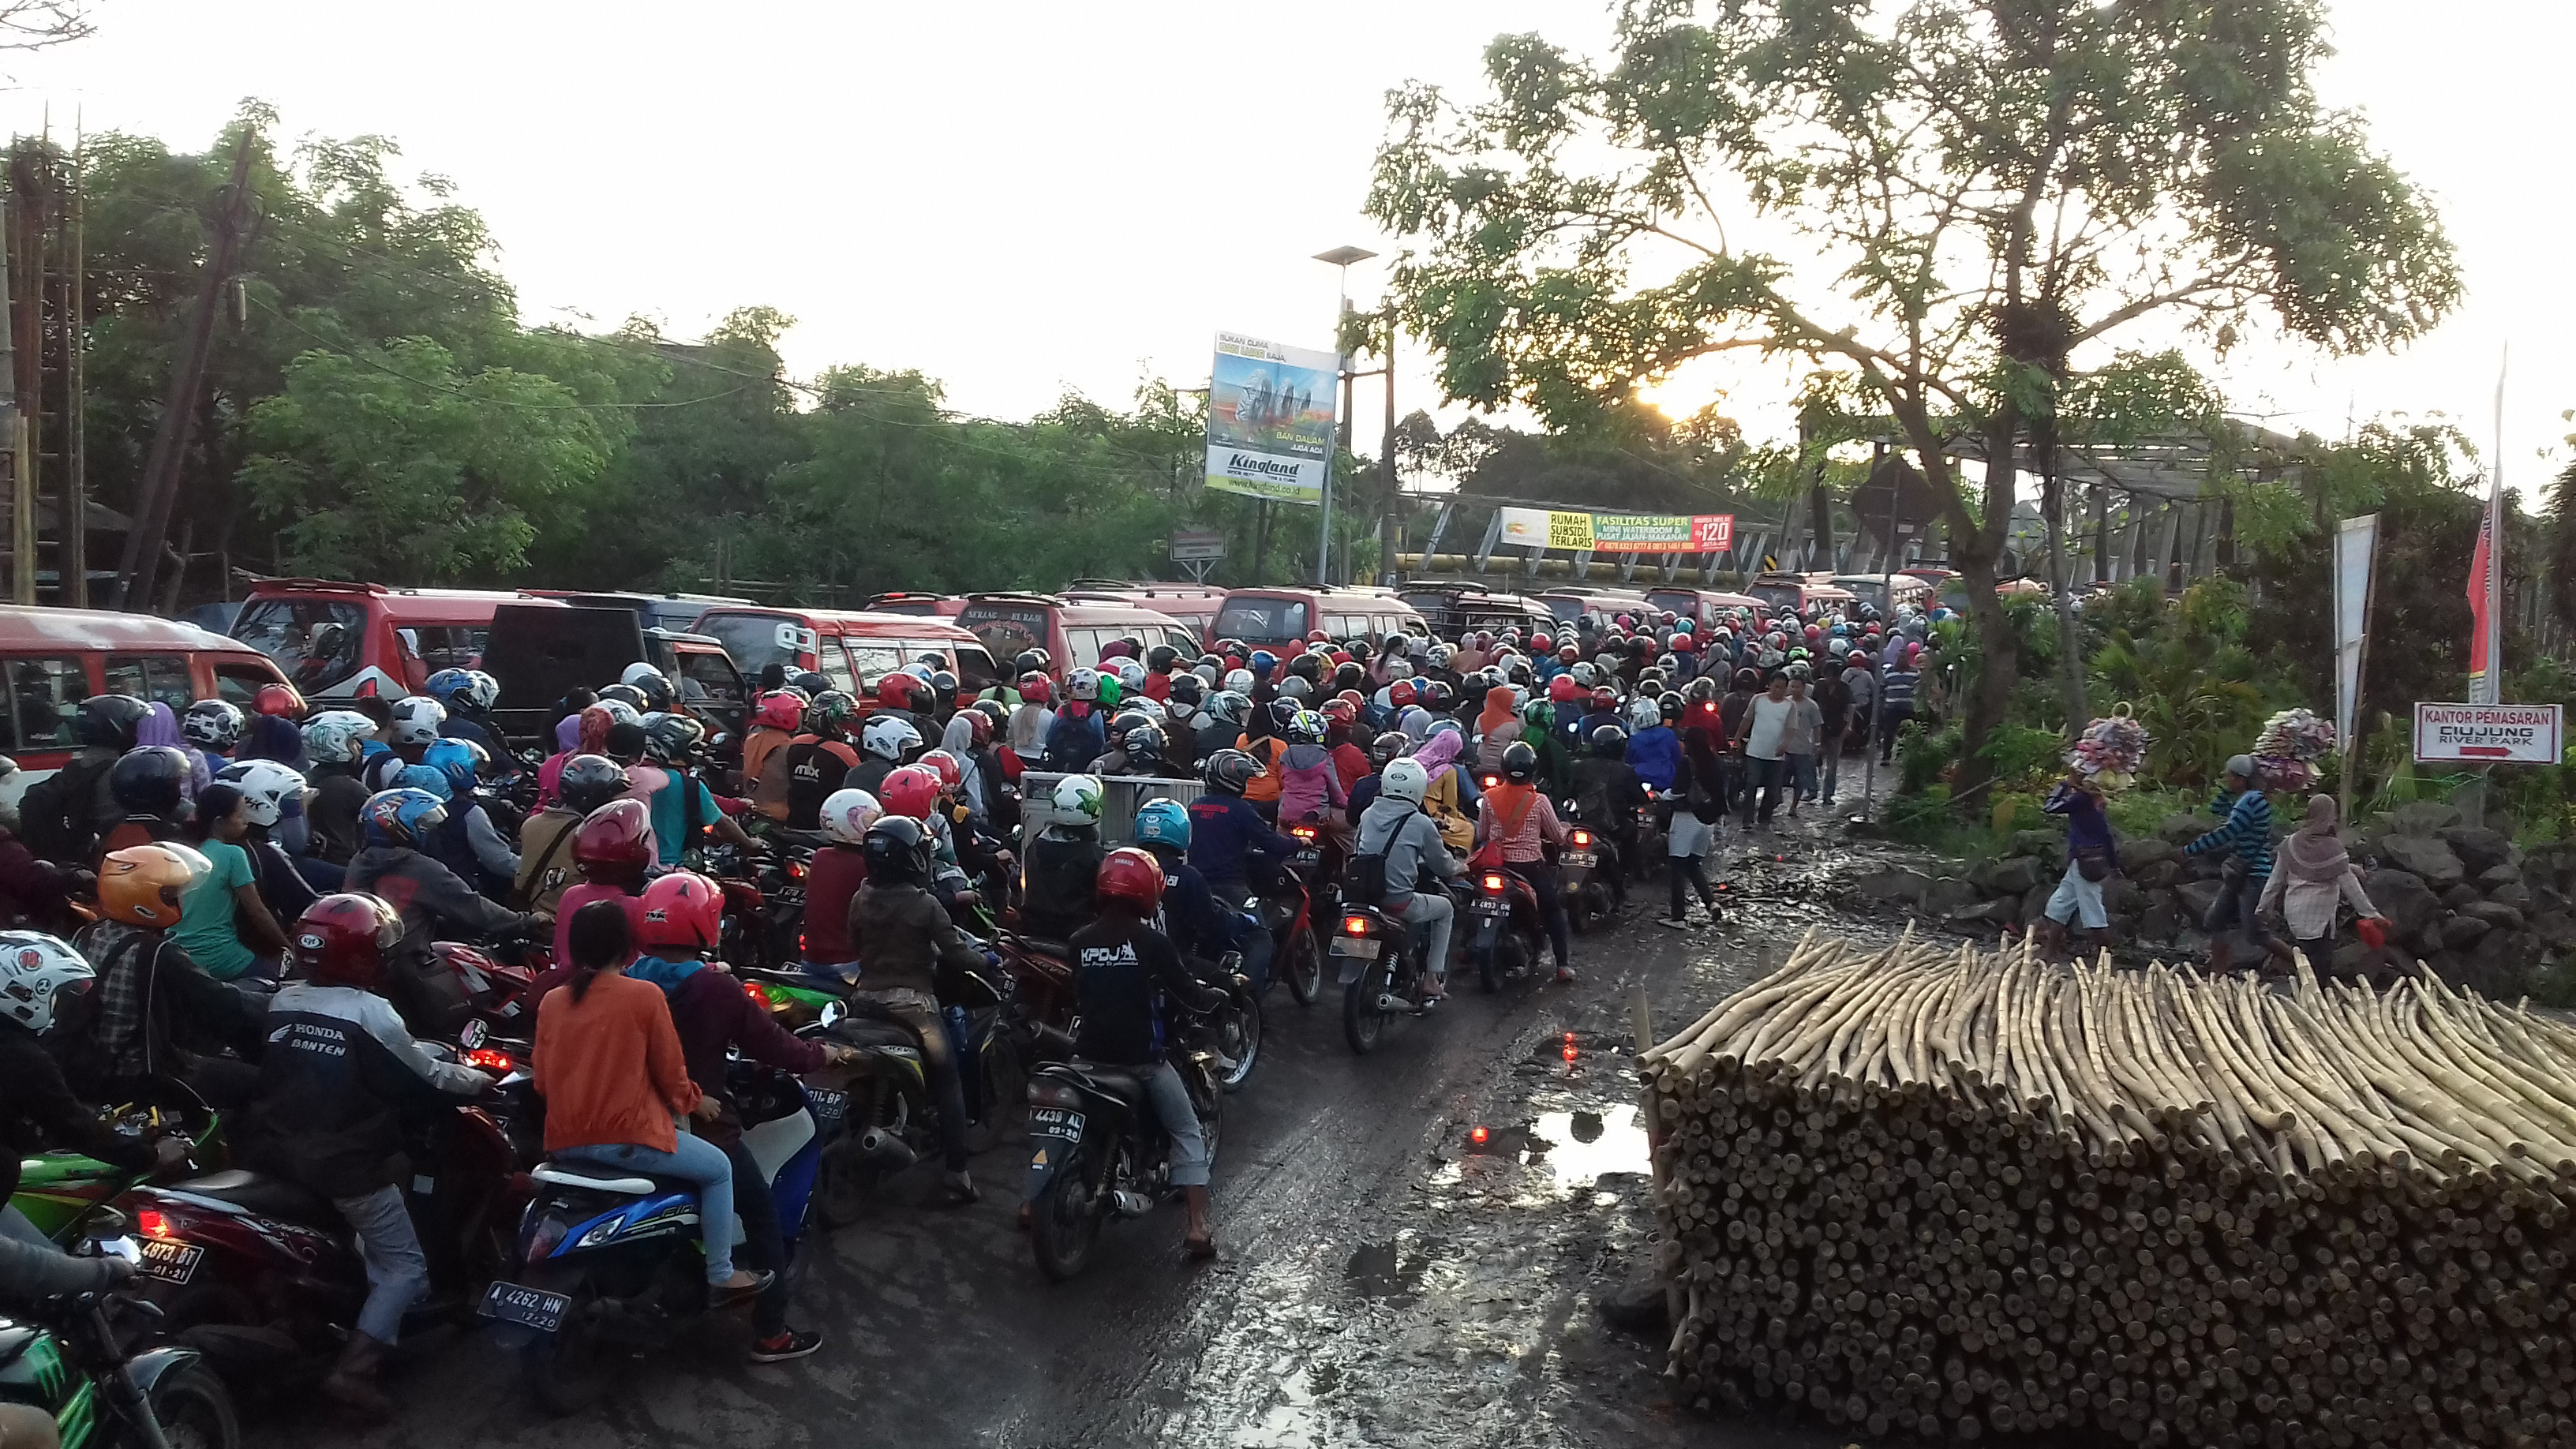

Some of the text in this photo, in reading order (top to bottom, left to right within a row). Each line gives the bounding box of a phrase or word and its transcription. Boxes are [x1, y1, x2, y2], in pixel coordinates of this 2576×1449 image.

[1247, 339, 1268, 349] CUMA
[1276, 432, 1325, 445] BAN DALAM
[1228, 454, 1300, 475] Kingland
[1551, 514, 1587, 526] RUMAH
[1596, 516, 1688, 526] FASILITAS SUPER
[1551, 525, 1587, 537] SUBSIDI
[1702, 522, 1729, 541] 120
[1551, 535, 1593, 548] TERLARIS
[2425, 710, 2550, 725] KANTOR PEMASARAN
[2439, 726, 2534, 737] CIUJUNG
[2490, 737, 2533, 746] PARK
[294, 1024, 346, 1042] HONDA
[290, 1039, 346, 1057] BANTEN
[826, 1091, 842, 1105] BP
[1035, 1109, 1080, 1129] 4439 AL
[142, 1241, 197, 1266] 4873 BT
[490, 1286, 564, 1315] A 4262 HN
